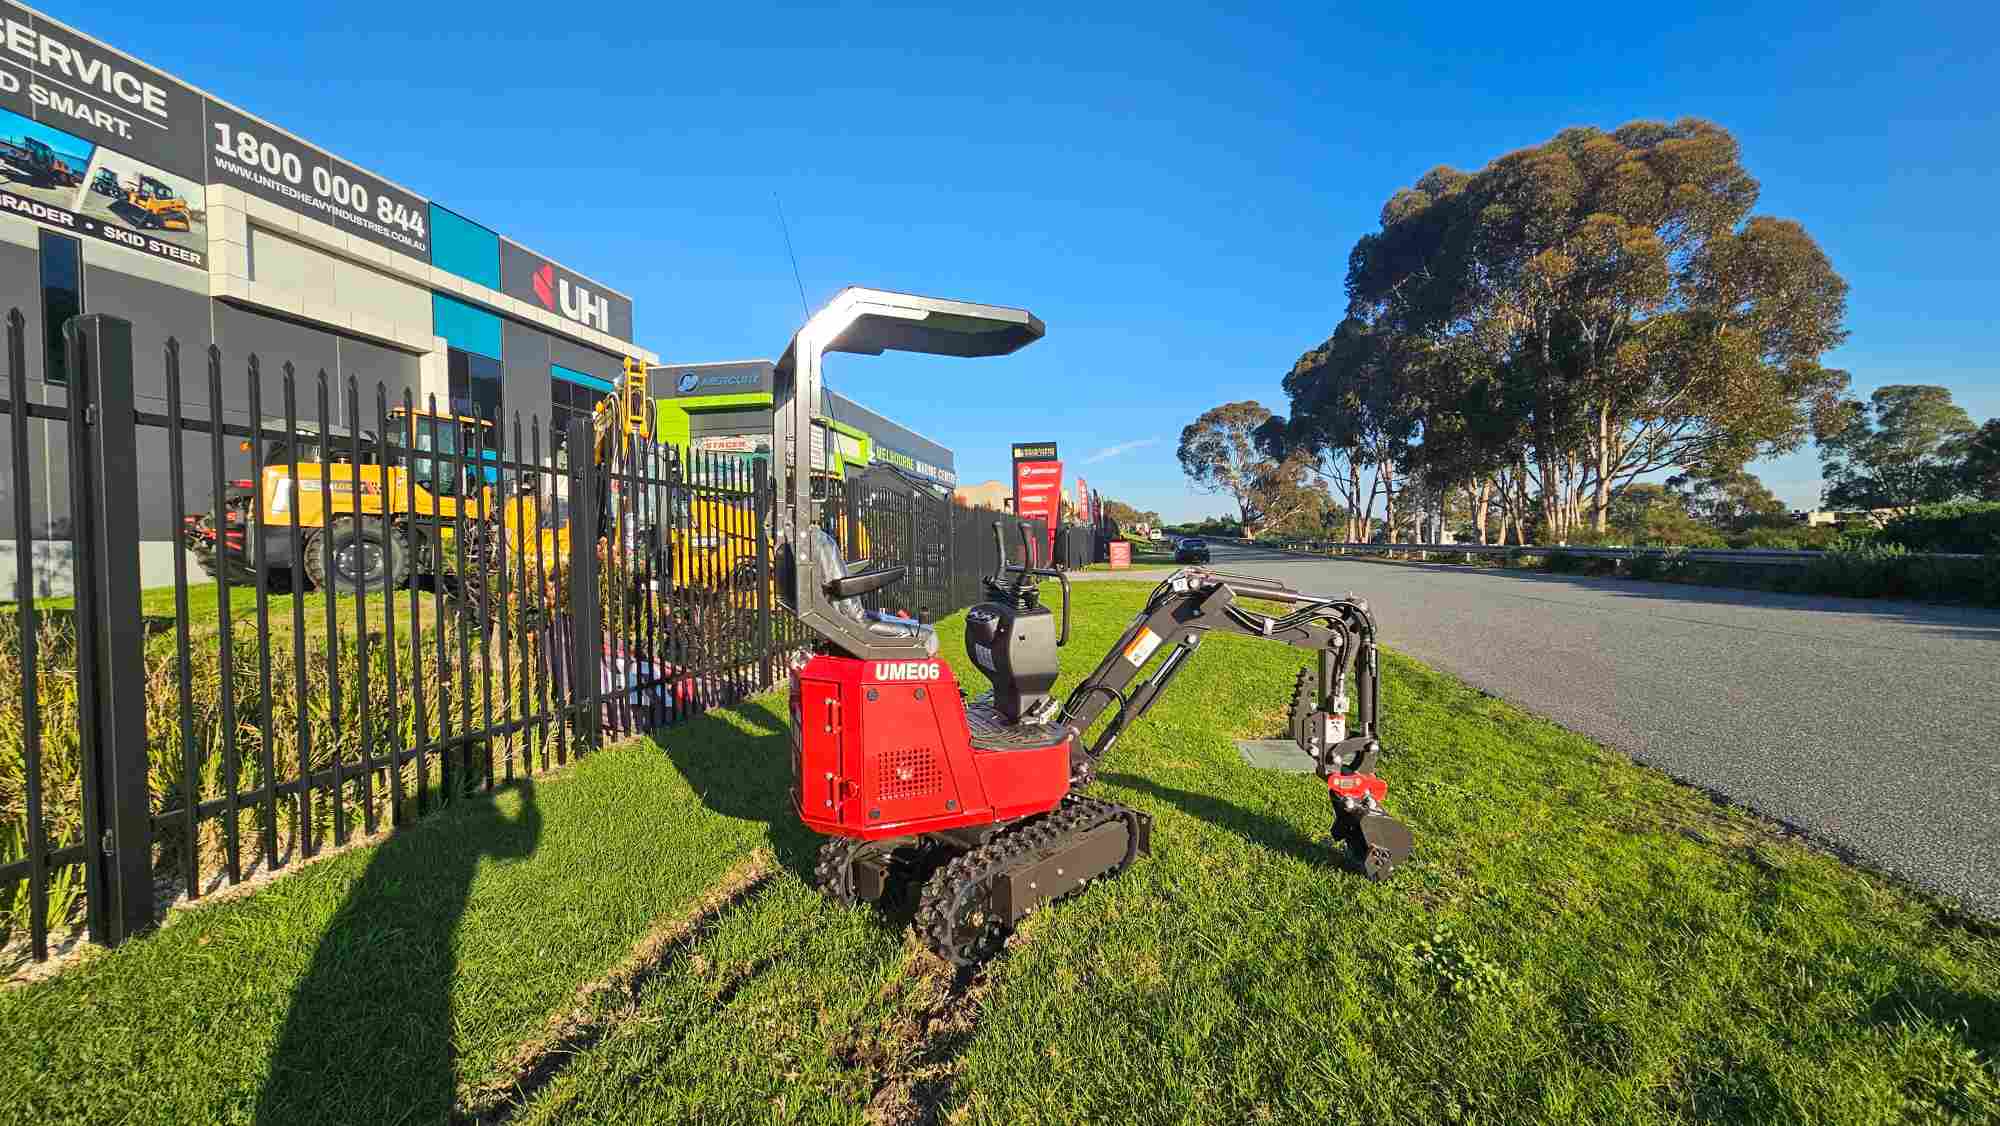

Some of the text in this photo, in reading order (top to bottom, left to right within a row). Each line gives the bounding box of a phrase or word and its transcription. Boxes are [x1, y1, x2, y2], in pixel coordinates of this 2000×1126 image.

[0, 17, 168, 118] ERVICE
[29, 83, 133, 140] SMART.
[214, 122, 425, 238] 1800 000 844
[214, 156, 425, 252] WWW.UNITEDHEAVYINDUSTRIES.COM.AU
[0, 193, 201, 265] RADER SKID STEER
[559, 278, 608, 333] UHI
[875, 662, 940, 681] UME06
